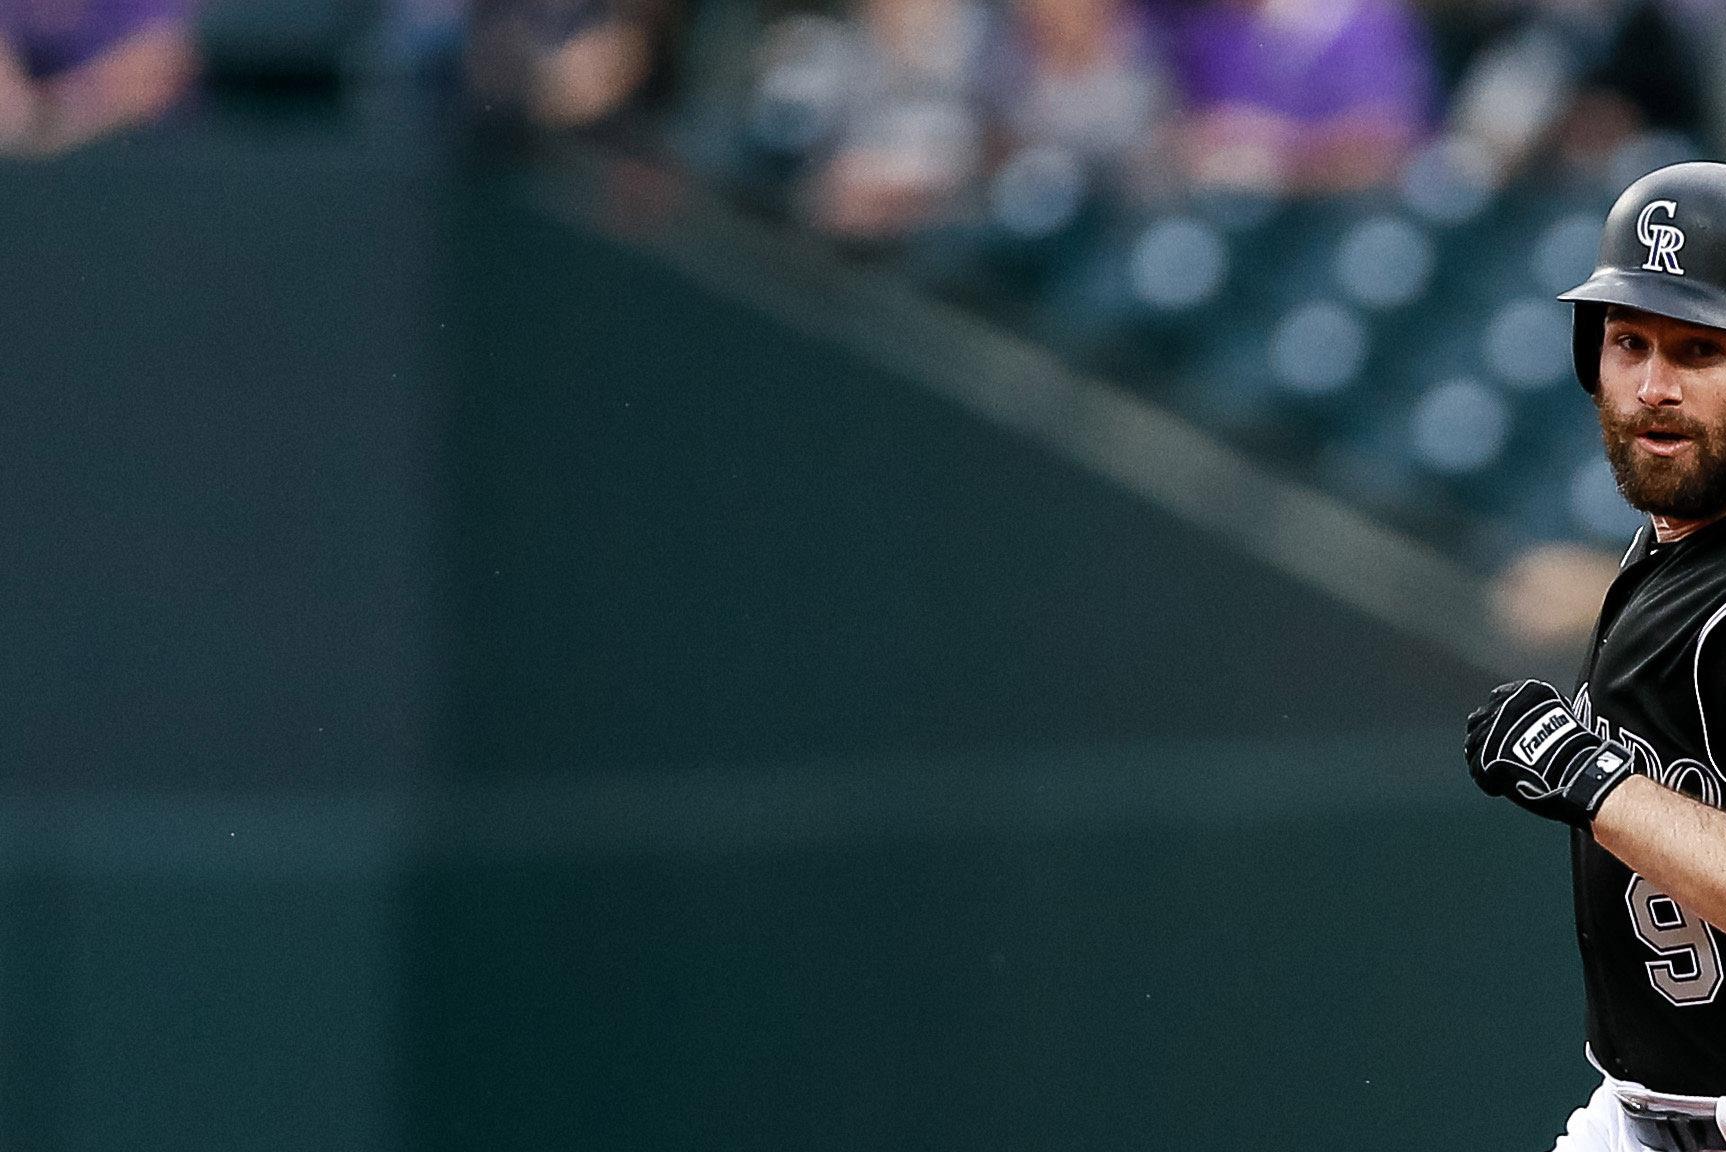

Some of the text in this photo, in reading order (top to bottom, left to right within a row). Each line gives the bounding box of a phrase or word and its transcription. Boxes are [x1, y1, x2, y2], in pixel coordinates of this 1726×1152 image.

[1637, 200, 1685, 275] CR
[1518, 713, 1570, 763] Franklin
[1624, 872, 1725, 1007] 9
